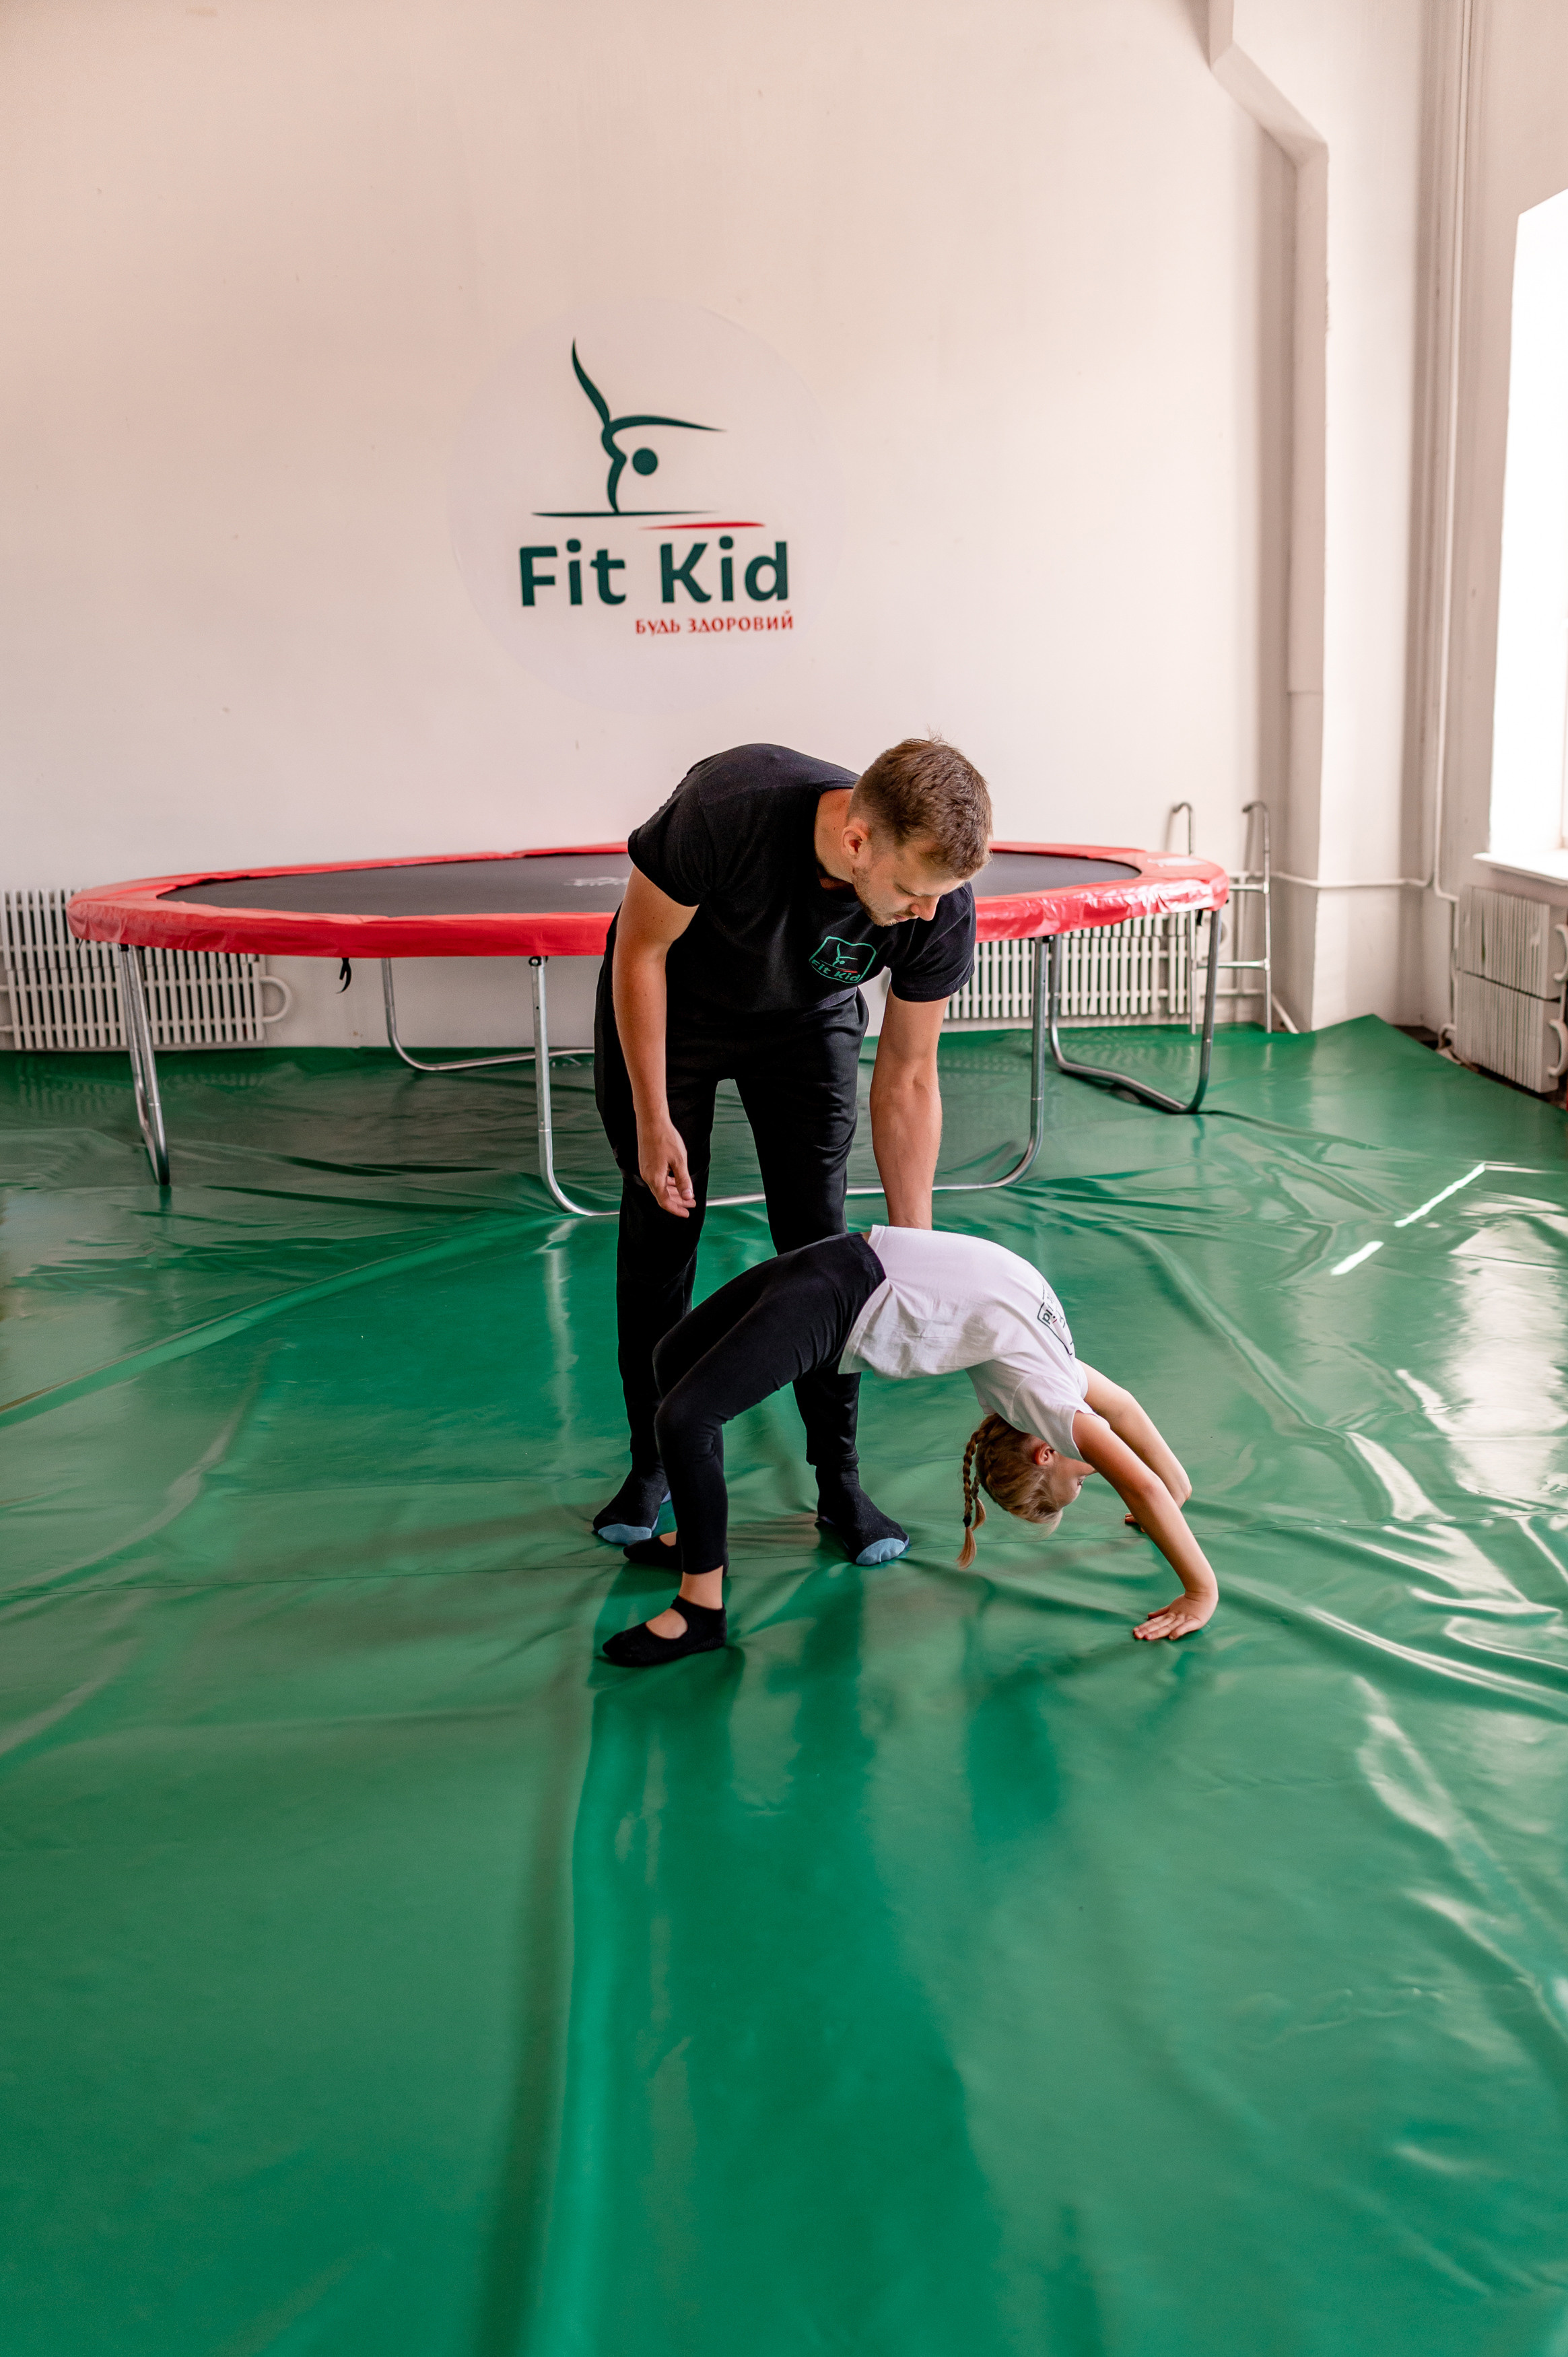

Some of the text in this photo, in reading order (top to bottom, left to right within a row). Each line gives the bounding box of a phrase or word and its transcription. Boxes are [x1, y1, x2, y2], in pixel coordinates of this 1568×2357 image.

[519, 535, 788, 607] Fit Kid
[635, 609, 794, 635] БУДЬ ЗДОРОВИЙ
[811, 959, 861, 981] Fit Kid
